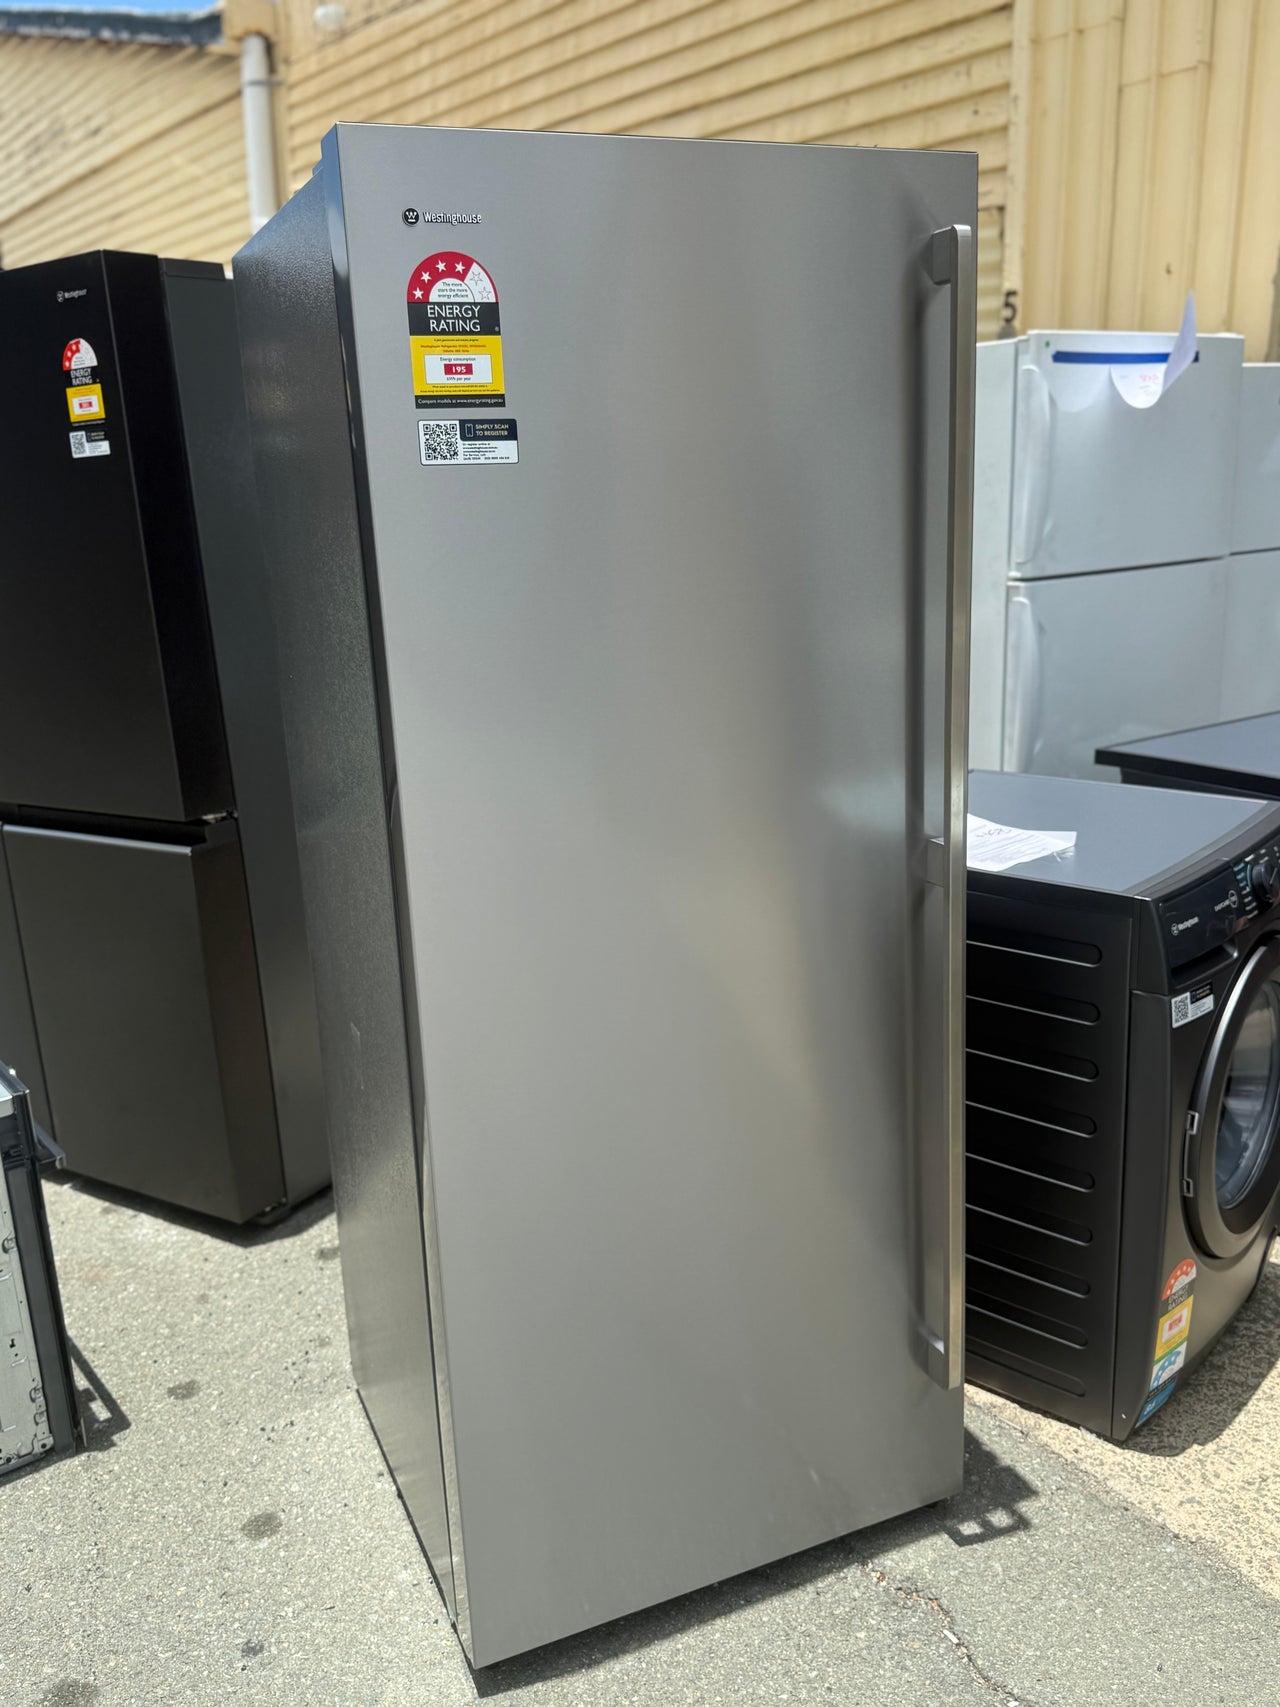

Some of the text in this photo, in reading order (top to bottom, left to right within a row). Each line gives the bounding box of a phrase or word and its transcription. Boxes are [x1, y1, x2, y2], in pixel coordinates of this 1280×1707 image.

[423, 211, 482, 226] Westinghouse
[427, 305, 481, 317] ENERGY
[1002, 290, 1018, 323] 5
[430, 319, 480, 332] RATING
[70, 368, 92, 378] ENERGY
[72, 376, 93, 385] RATING
